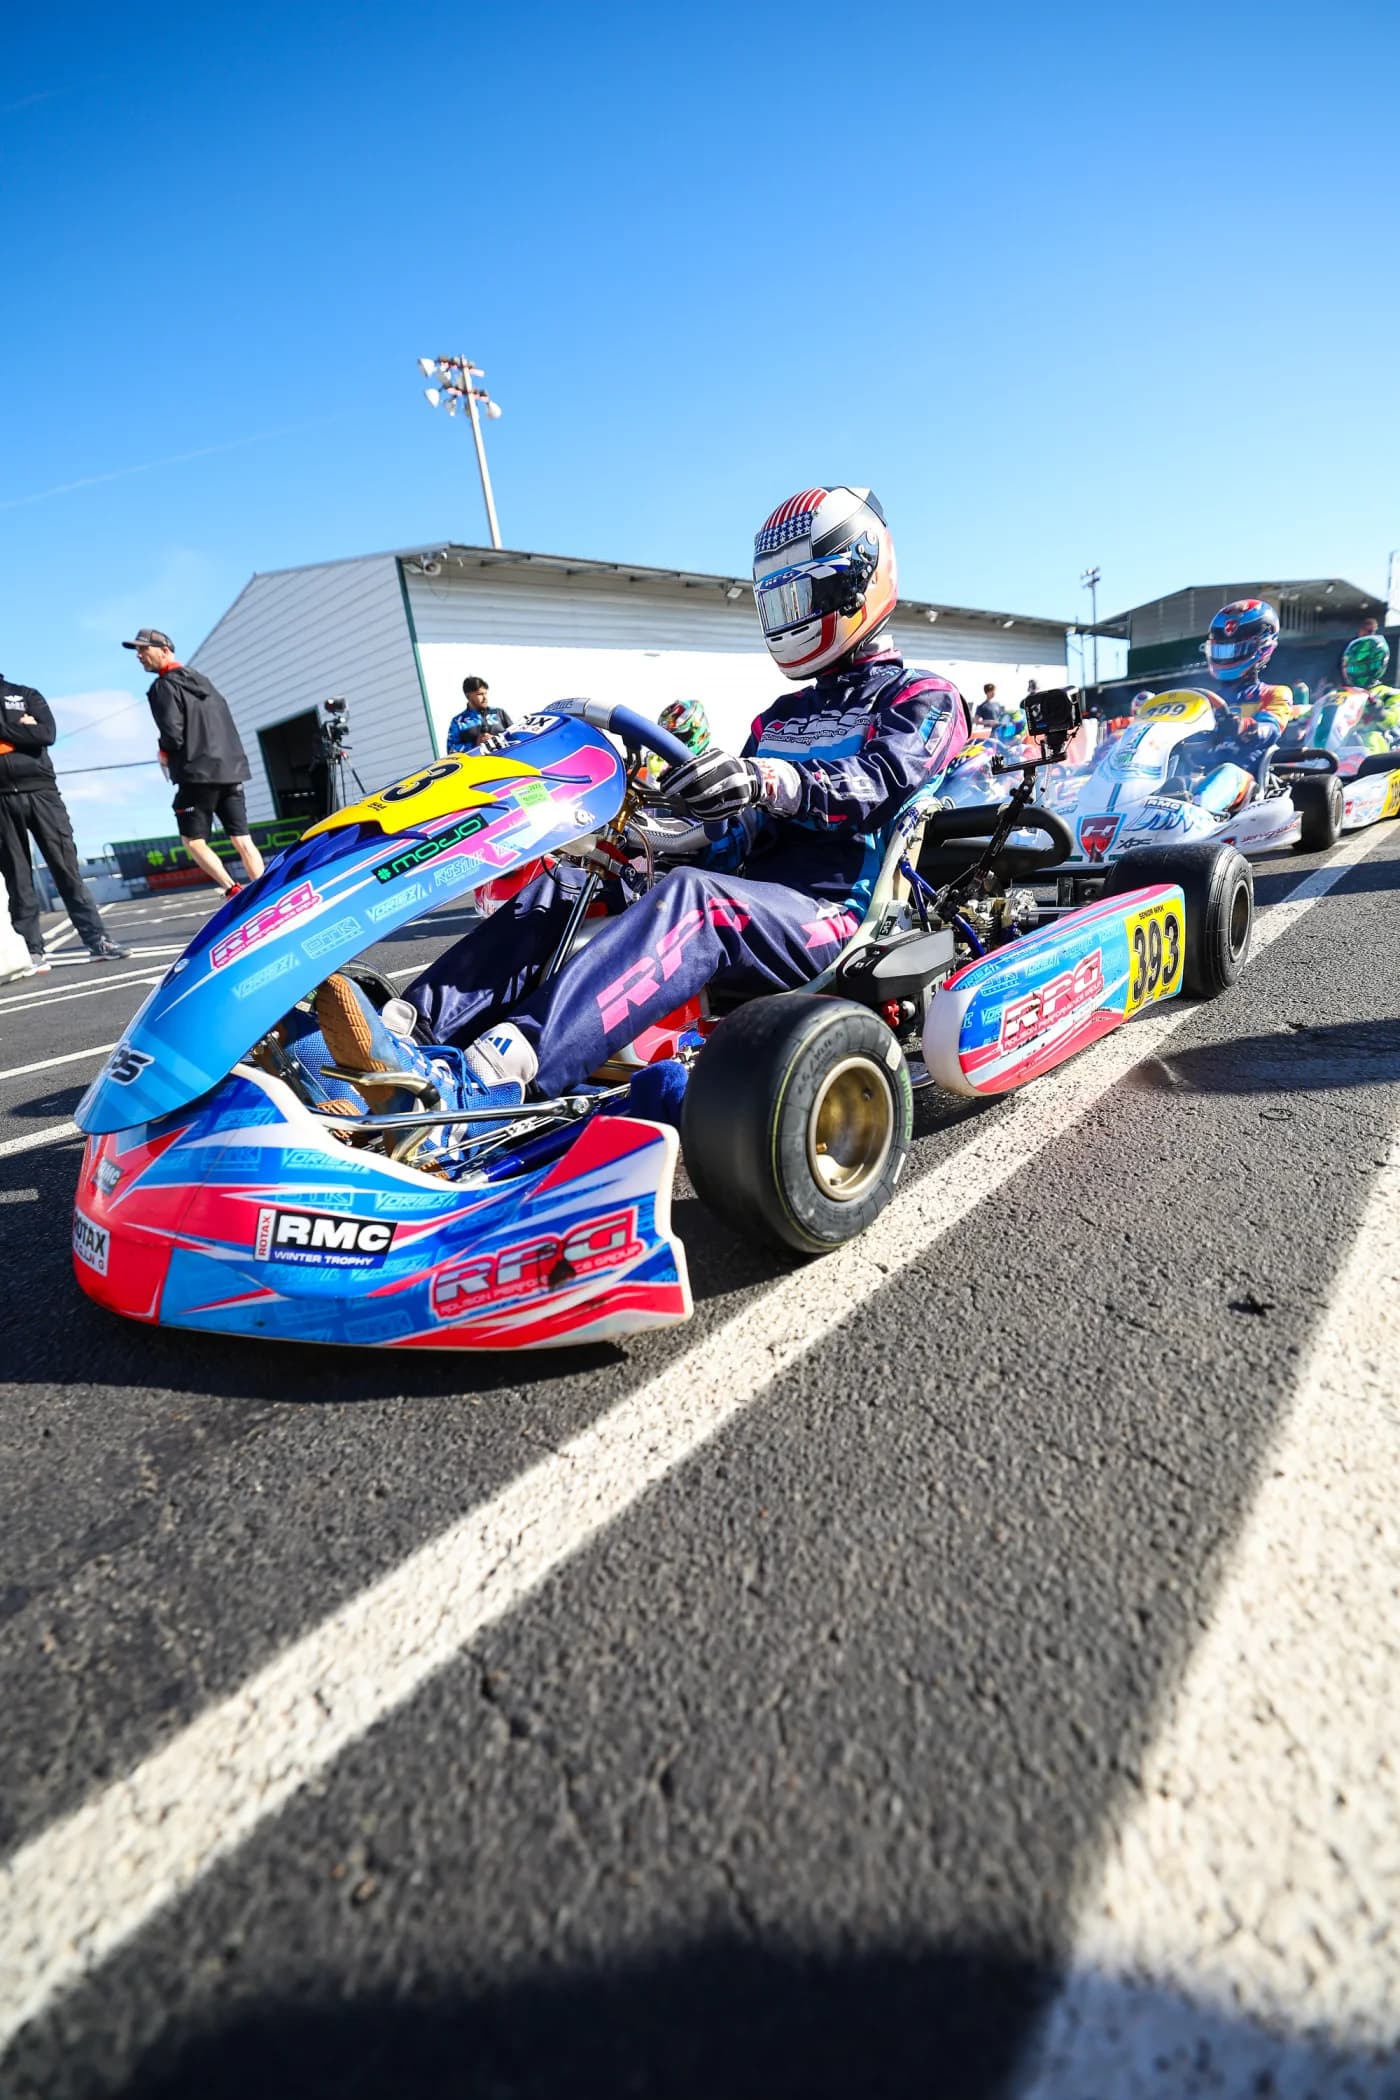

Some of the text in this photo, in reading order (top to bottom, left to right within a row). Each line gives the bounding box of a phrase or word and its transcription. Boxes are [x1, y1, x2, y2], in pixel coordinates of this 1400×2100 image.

[214, 887, 311, 963] RPG
[1132, 912, 1180, 1003] 393
[1004, 956, 1100, 1038] RPG
[258, 1215, 272, 1257] ROTAX
[273, 1250, 375, 1266] WINTER TROPHY
[276, 1214, 392, 1252] RMC
[435, 1215, 628, 1305] RPG
